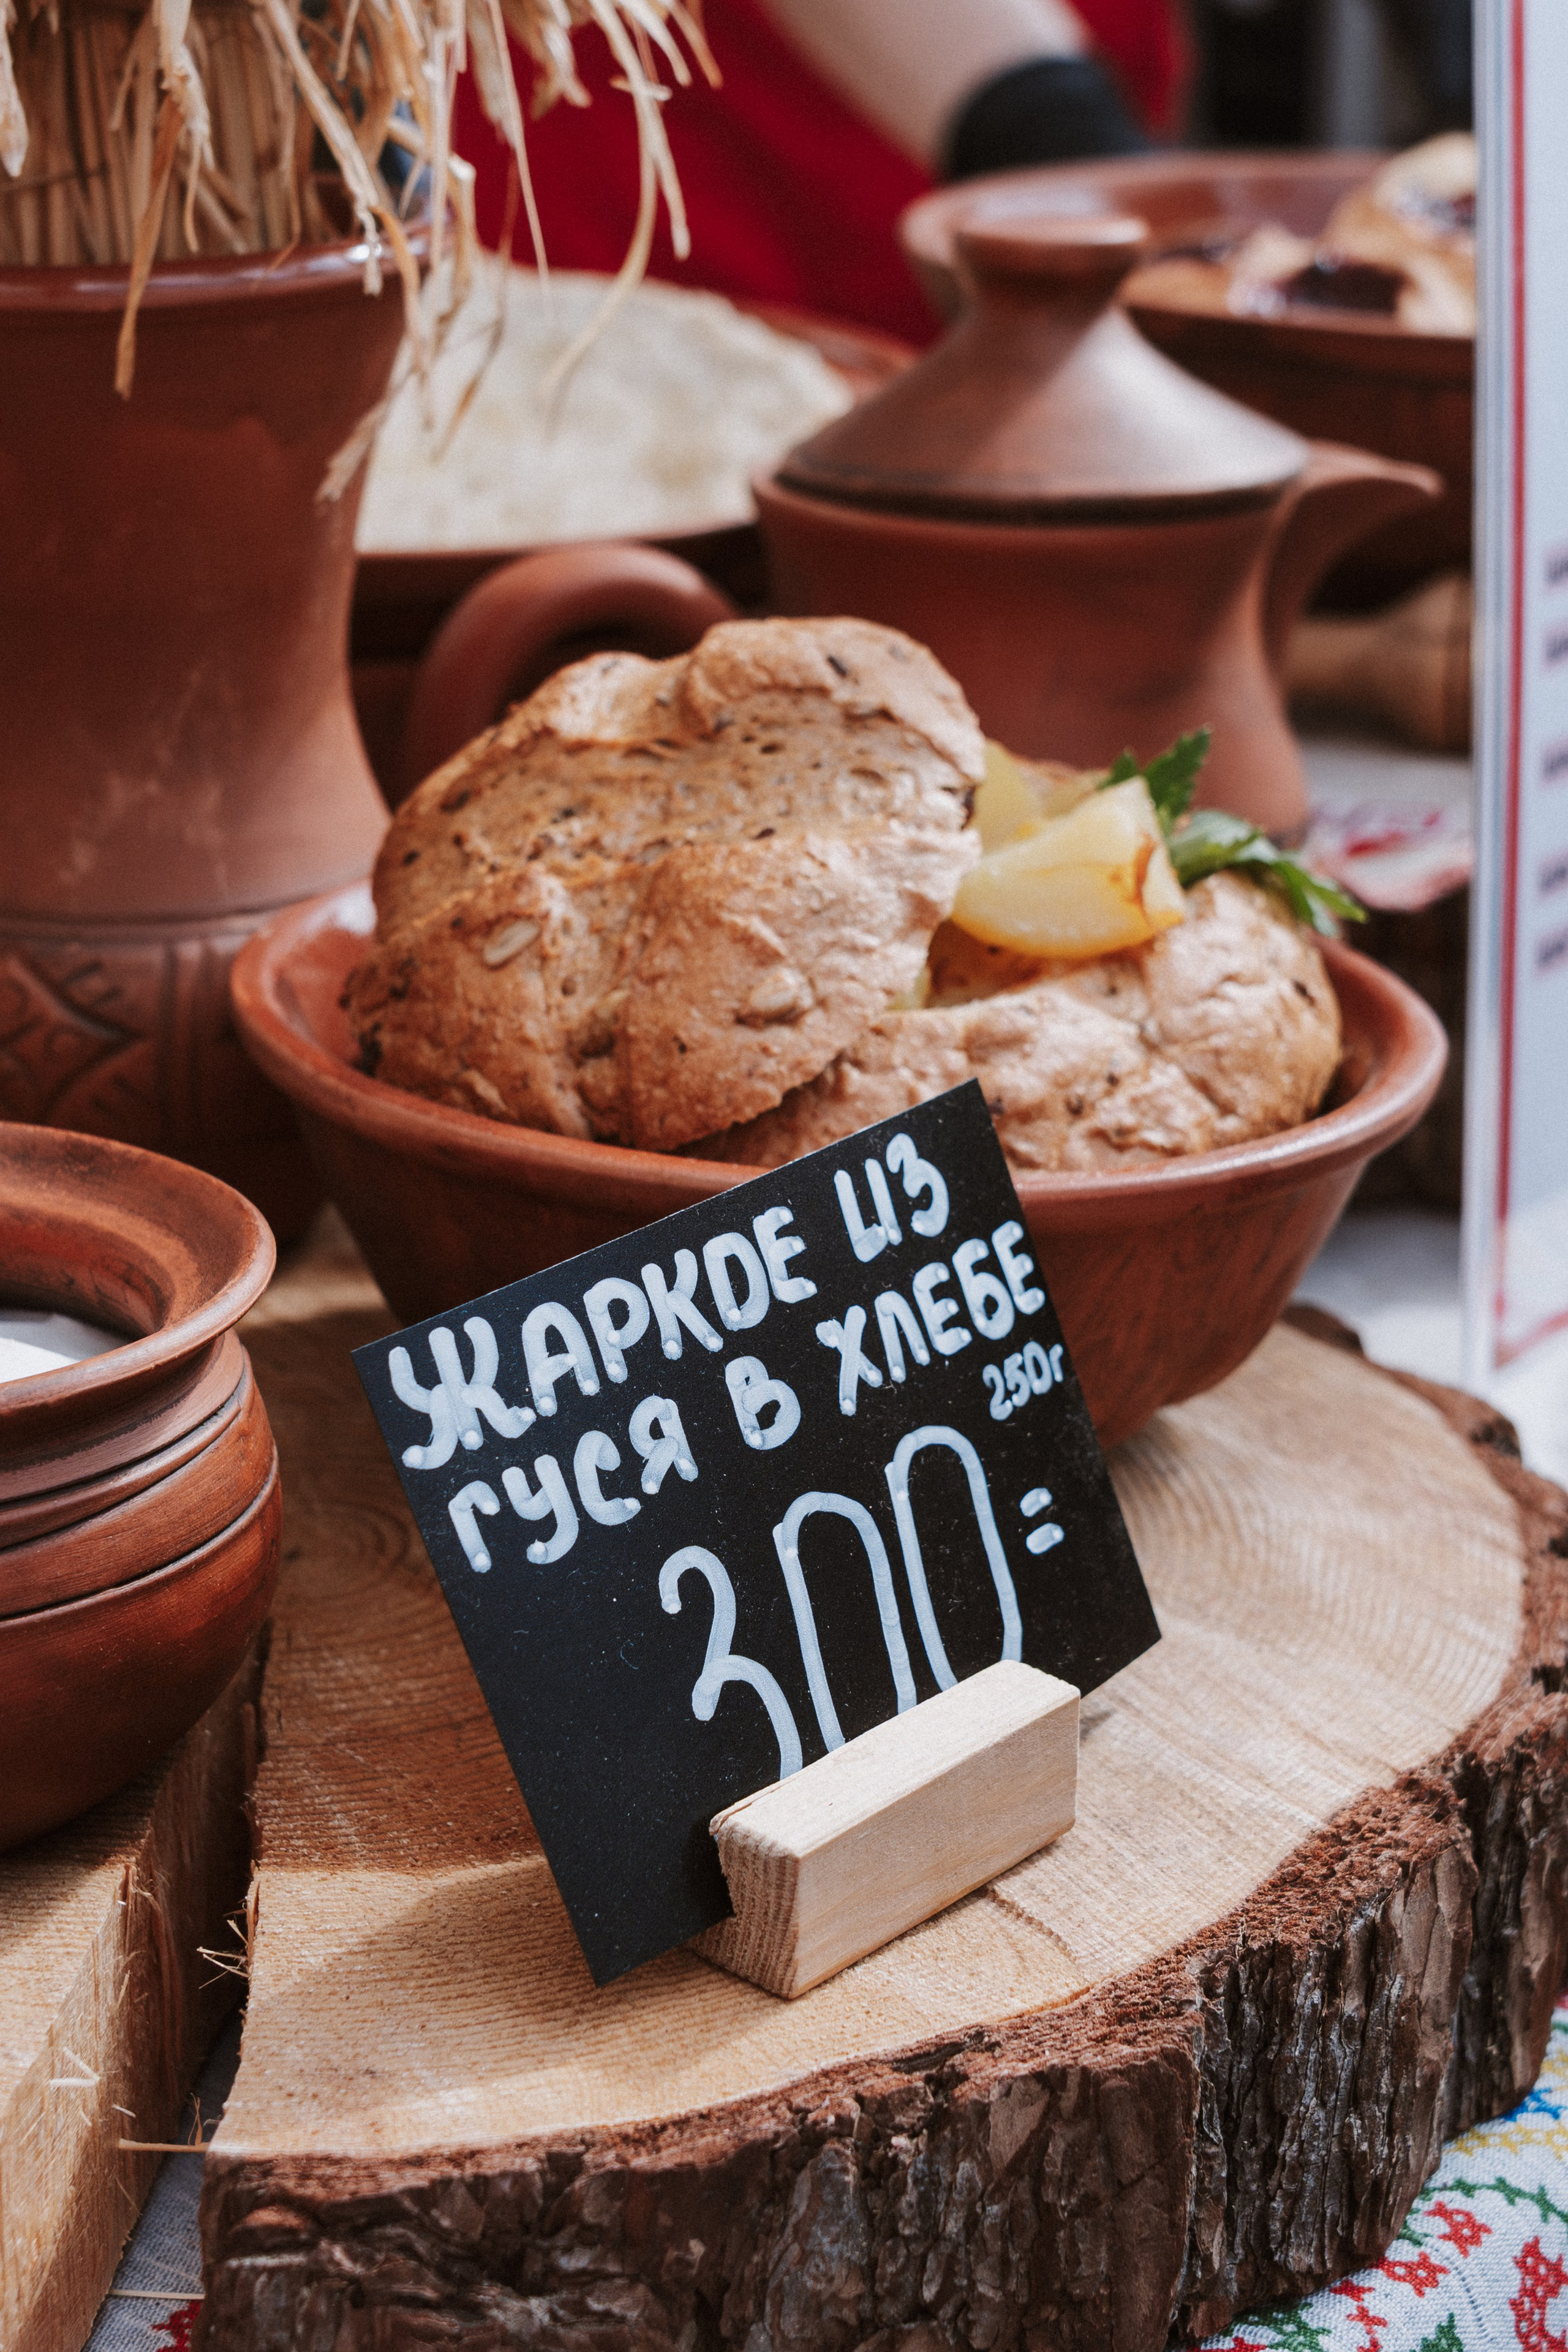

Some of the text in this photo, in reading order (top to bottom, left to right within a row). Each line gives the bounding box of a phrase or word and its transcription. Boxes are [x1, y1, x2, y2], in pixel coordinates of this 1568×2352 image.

[388, 1133, 950, 1470] ЖАРКОЕ ИЗ
[447, 1220, 1046, 1574] ГУСЯ В ХЛЕБЕ
[982, 1341, 1065, 1421] 250г
